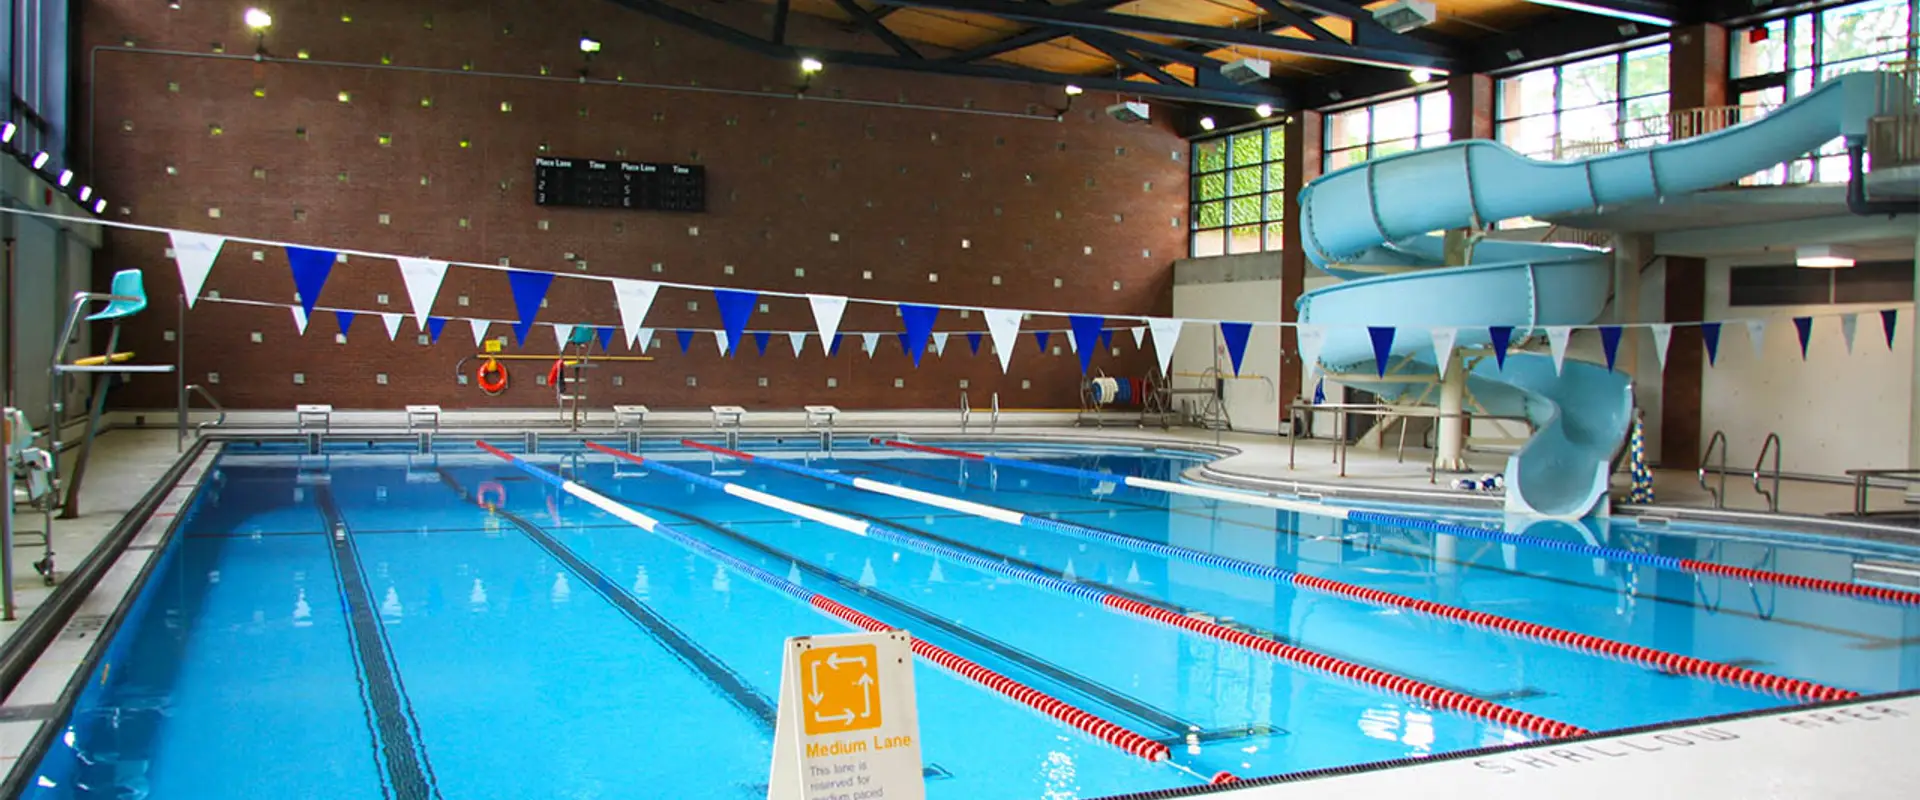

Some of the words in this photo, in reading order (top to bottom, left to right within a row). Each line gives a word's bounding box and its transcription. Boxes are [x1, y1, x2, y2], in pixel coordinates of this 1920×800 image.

[536, 158, 554, 167] Place
[555, 159, 572, 168] Lane
[589, 160, 606, 169] Time
[621, 162, 639, 171] Place
[640, 163, 656, 172] Lane
[673, 165, 689, 174] Time
[538, 180, 546, 190] 2
[538, 193, 546, 203] 3
[806, 740, 867, 759] Medium
[874, 735, 912, 751] Lane
[1474, 728, 1740, 775] SHALLOW
[1778, 705, 1910, 730] AREA
[811, 765, 831, 776] This
[834, 763, 855, 774] lane
[859, 761, 867, 771] is
[811, 777, 853, 791] reserved
[857, 775, 871, 785] for
[853, 785, 884, 800] paced
